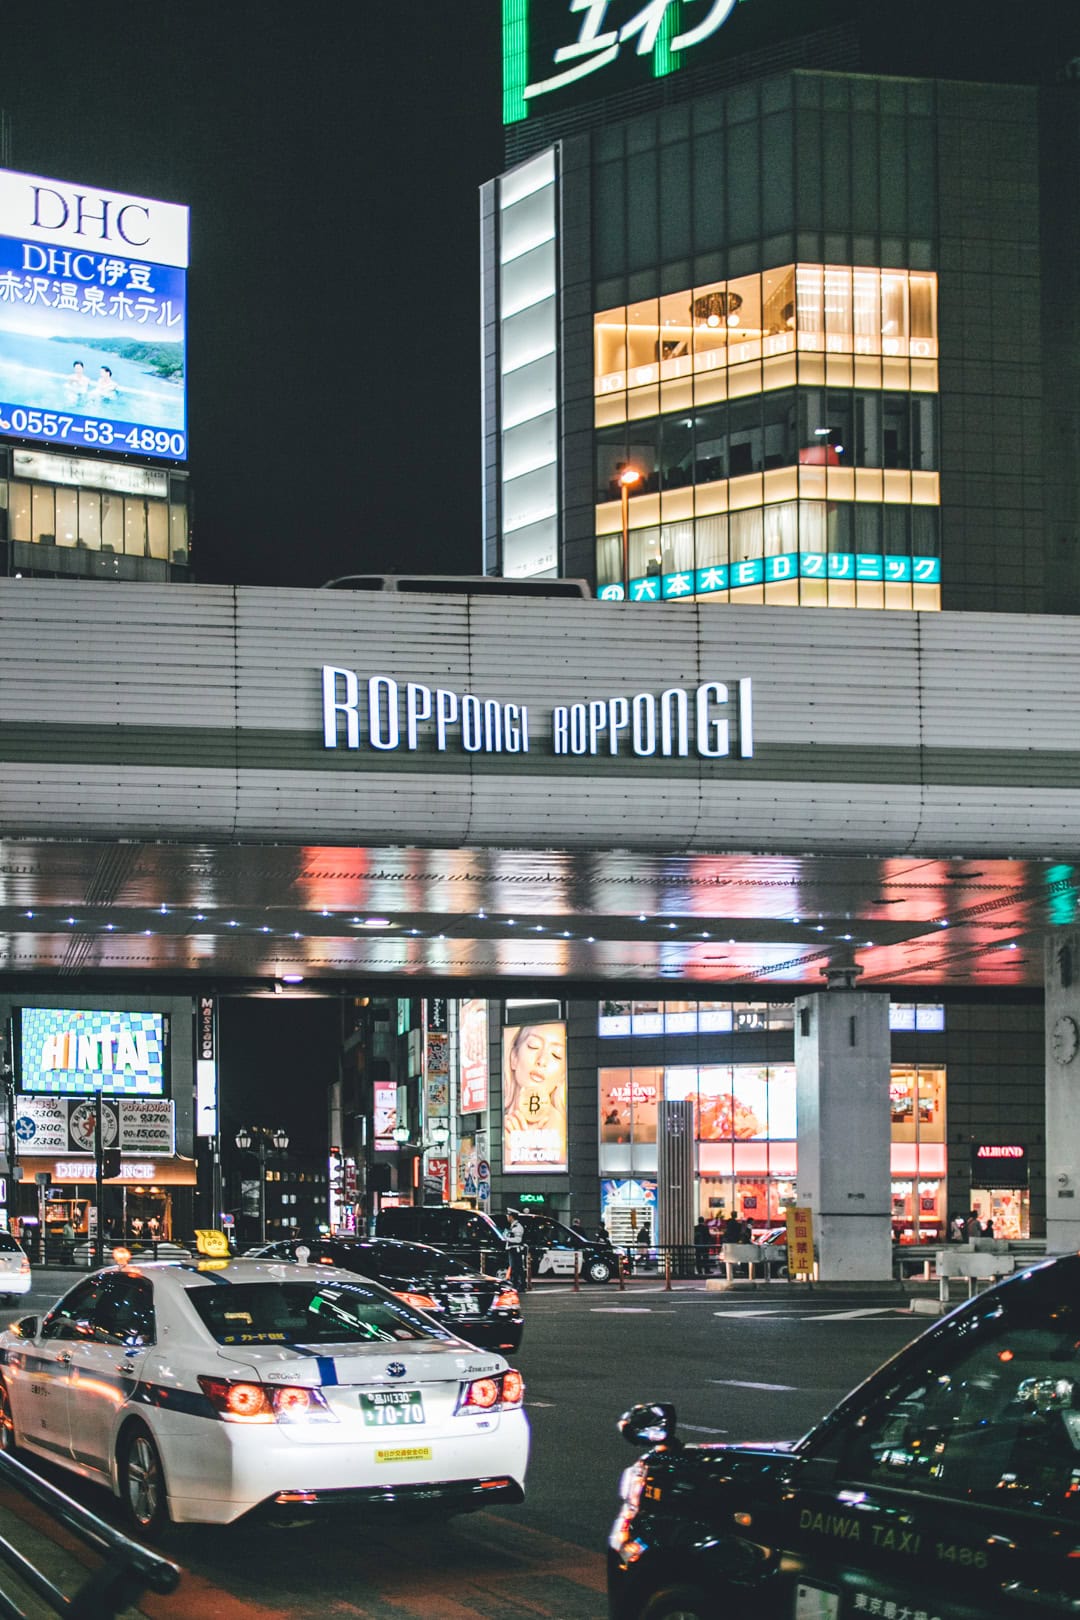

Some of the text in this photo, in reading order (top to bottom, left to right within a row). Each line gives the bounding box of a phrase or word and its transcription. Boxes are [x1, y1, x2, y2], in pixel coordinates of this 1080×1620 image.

[29, 185, 151, 247] DHC
[22, 243, 156, 294] DHC伊豆
[0, 271, 182, 328] 赤沢温泉ホテル
[11, 408, 186, 457] 0557-53-4890
[322, 664, 755, 760] ROPPONGI ROPPONGI
[373, 1403, 424, 1425] 70-70
[799, 1509, 861, 1541] DAIWA
[871, 1525, 921, 1554] TAXI
